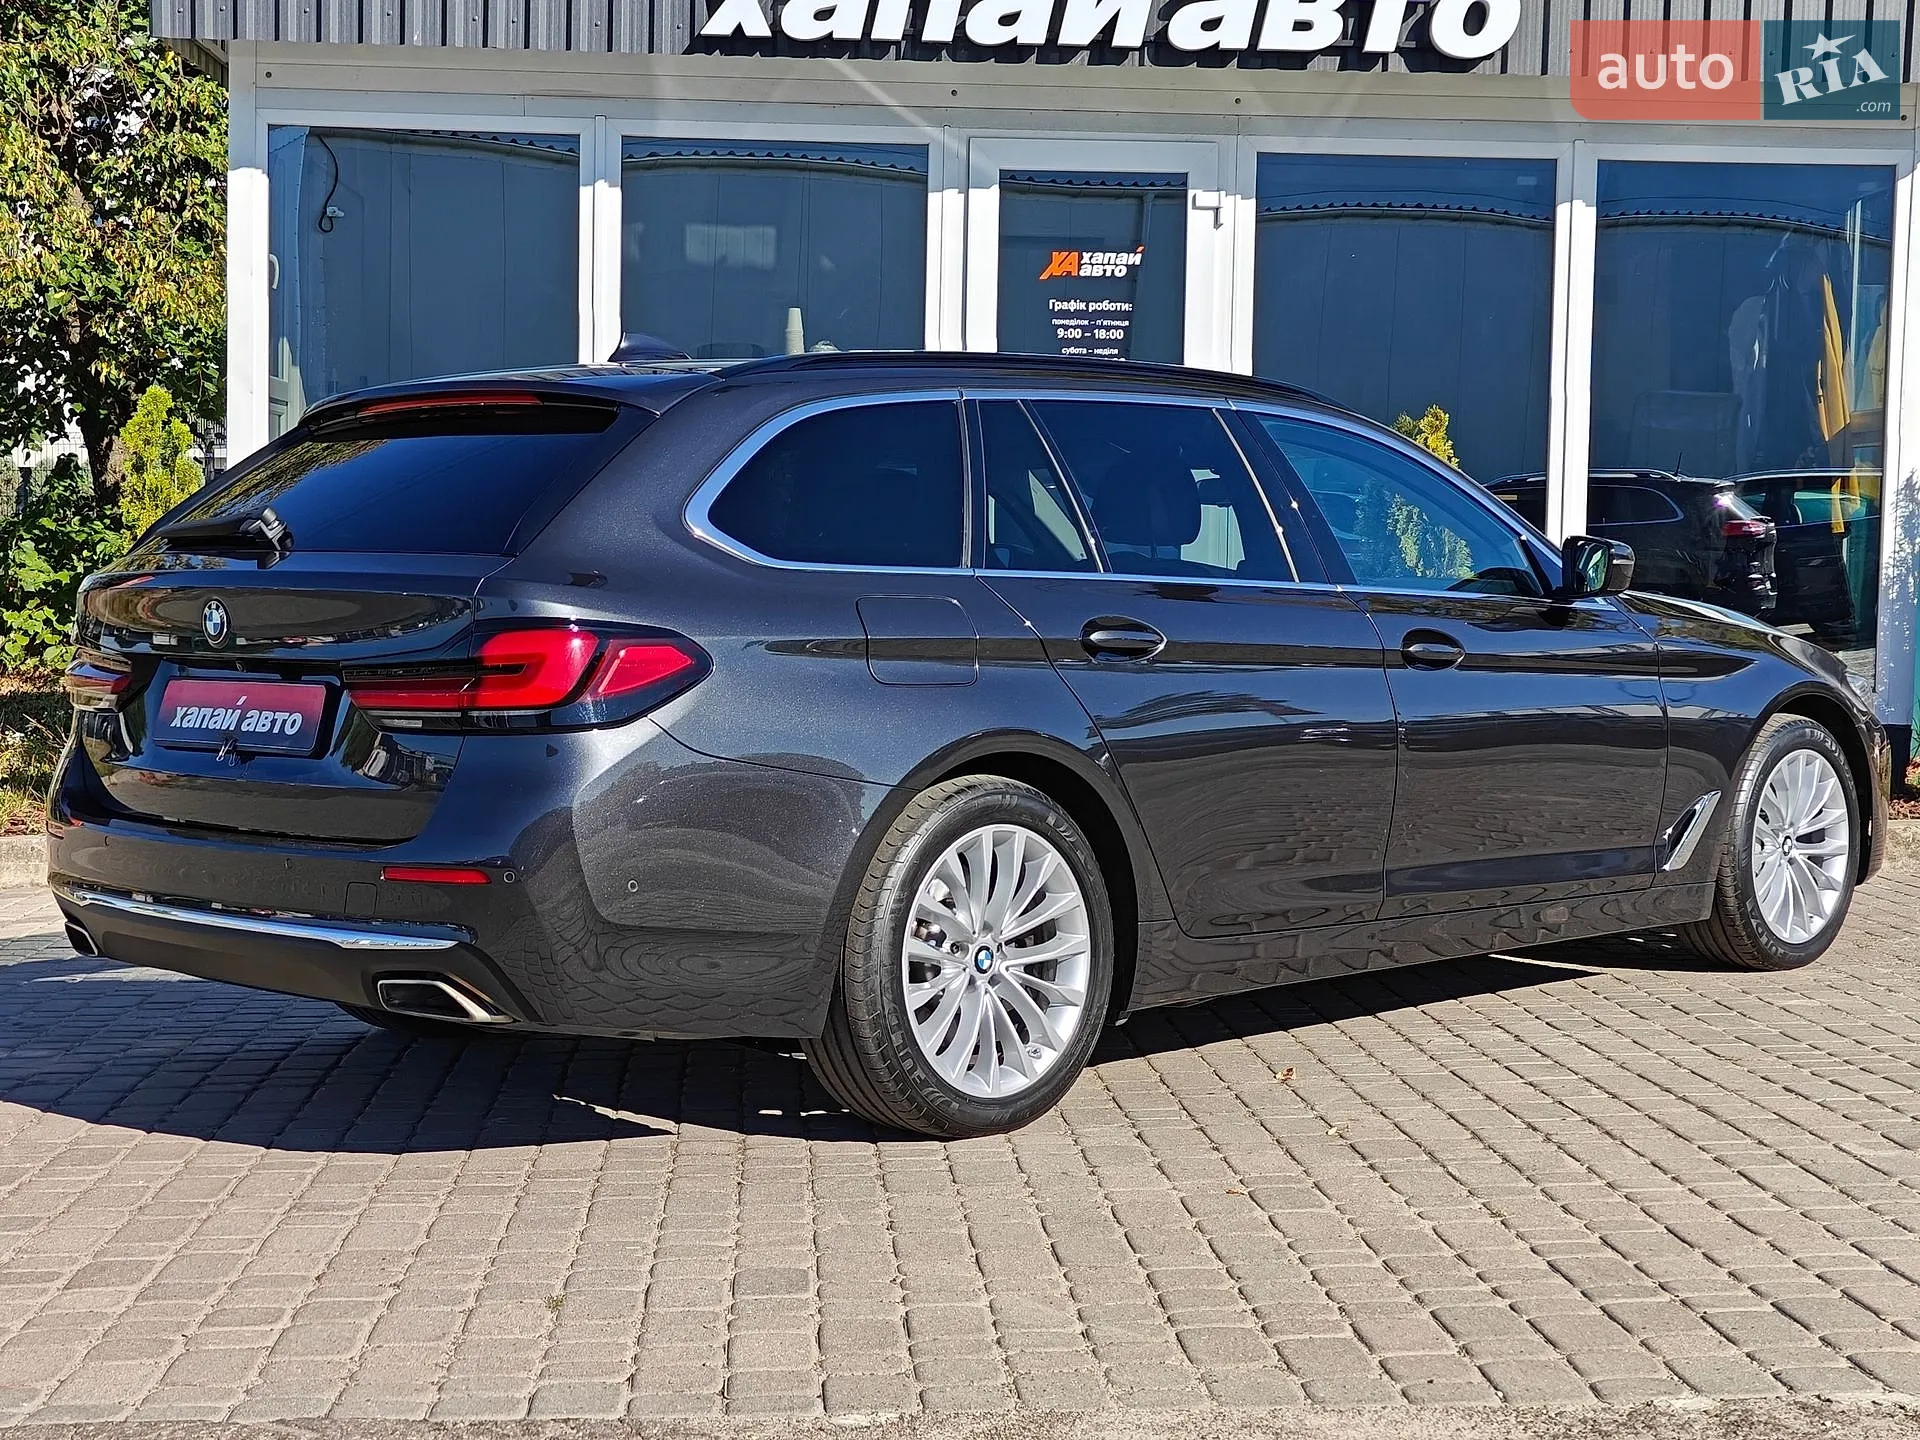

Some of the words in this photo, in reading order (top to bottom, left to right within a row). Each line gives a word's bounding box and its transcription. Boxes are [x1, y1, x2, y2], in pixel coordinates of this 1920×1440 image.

[1166, 0, 1523, 59] авто
[1080, 246, 1145, 265] хапай
[1079, 264, 1127, 278] авто
[1049, 299, 1087, 312] Графік
[1088, 300, 1133, 313] роботи:
[1052, 318, 1089, 326] понеділок
[1057, 328, 1082, 339] 9:00
[1093, 329, 1124, 339] 18:00
[1061, 347, 1087, 355] субота
[1094, 347, 1119, 355] неділя
[169, 695, 248, 731] хапай
[240, 709, 303, 735] авто
